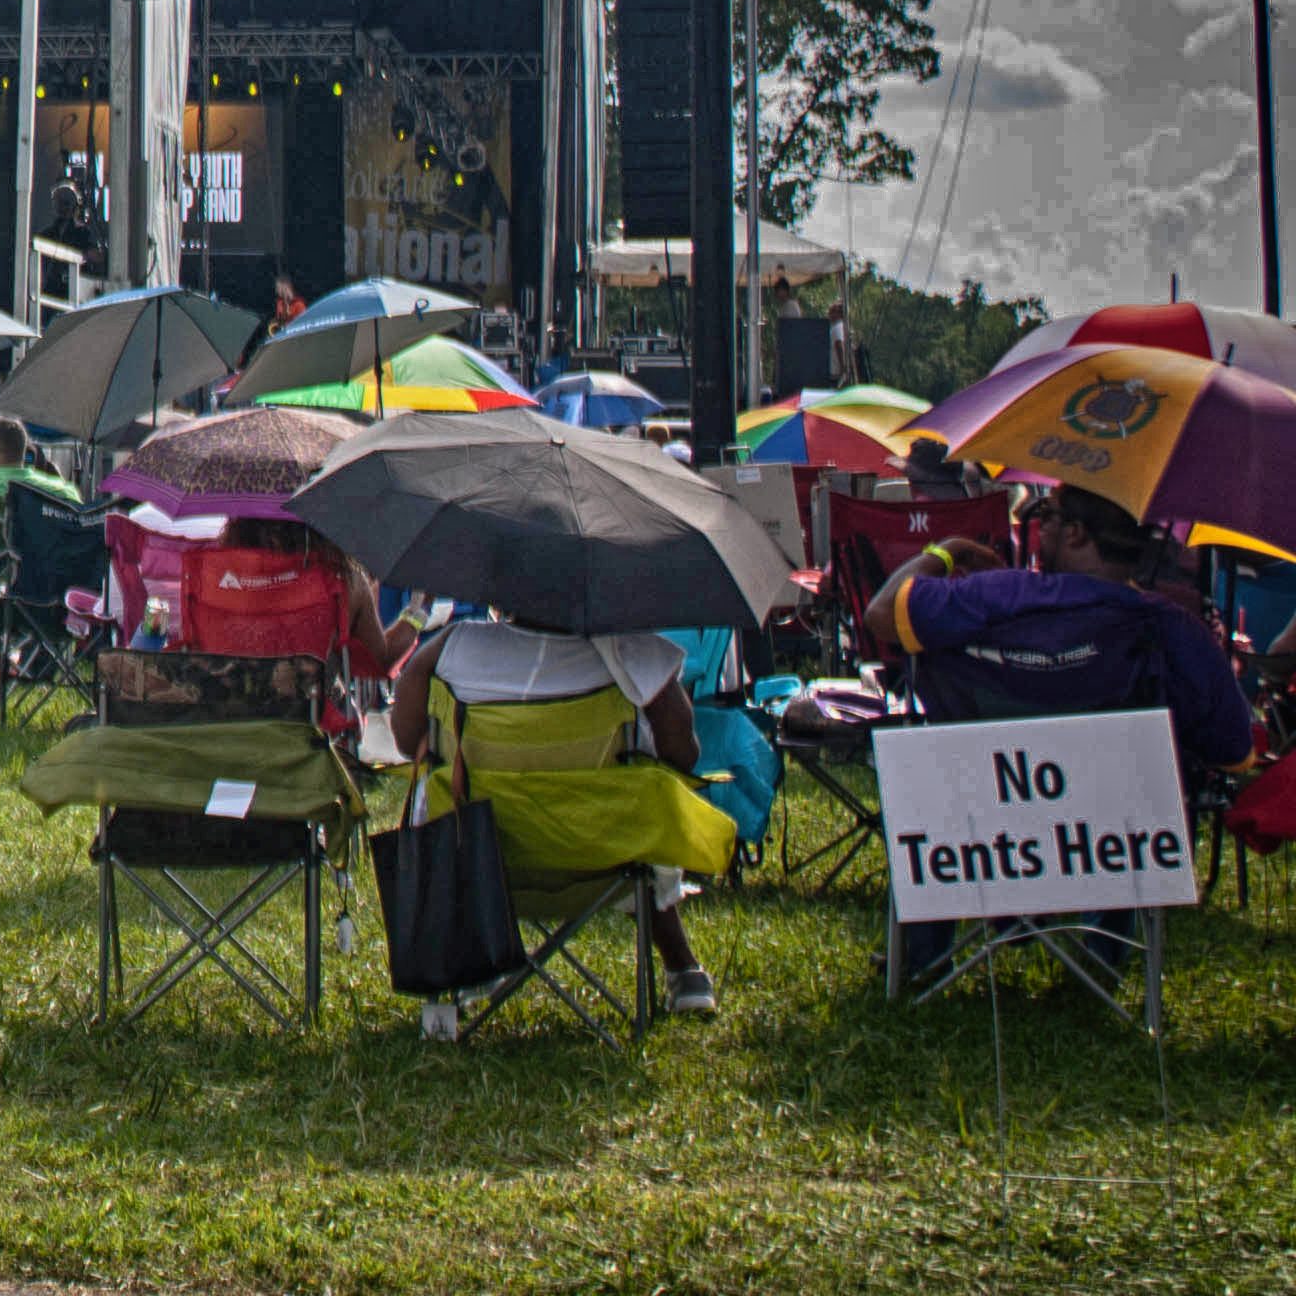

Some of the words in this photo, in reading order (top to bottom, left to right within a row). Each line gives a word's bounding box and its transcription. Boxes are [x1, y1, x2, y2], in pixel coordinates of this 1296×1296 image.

[992, 748, 1067, 803] No
[896, 831, 1045, 885] Tents
[1053, 820, 1181, 876] Here
